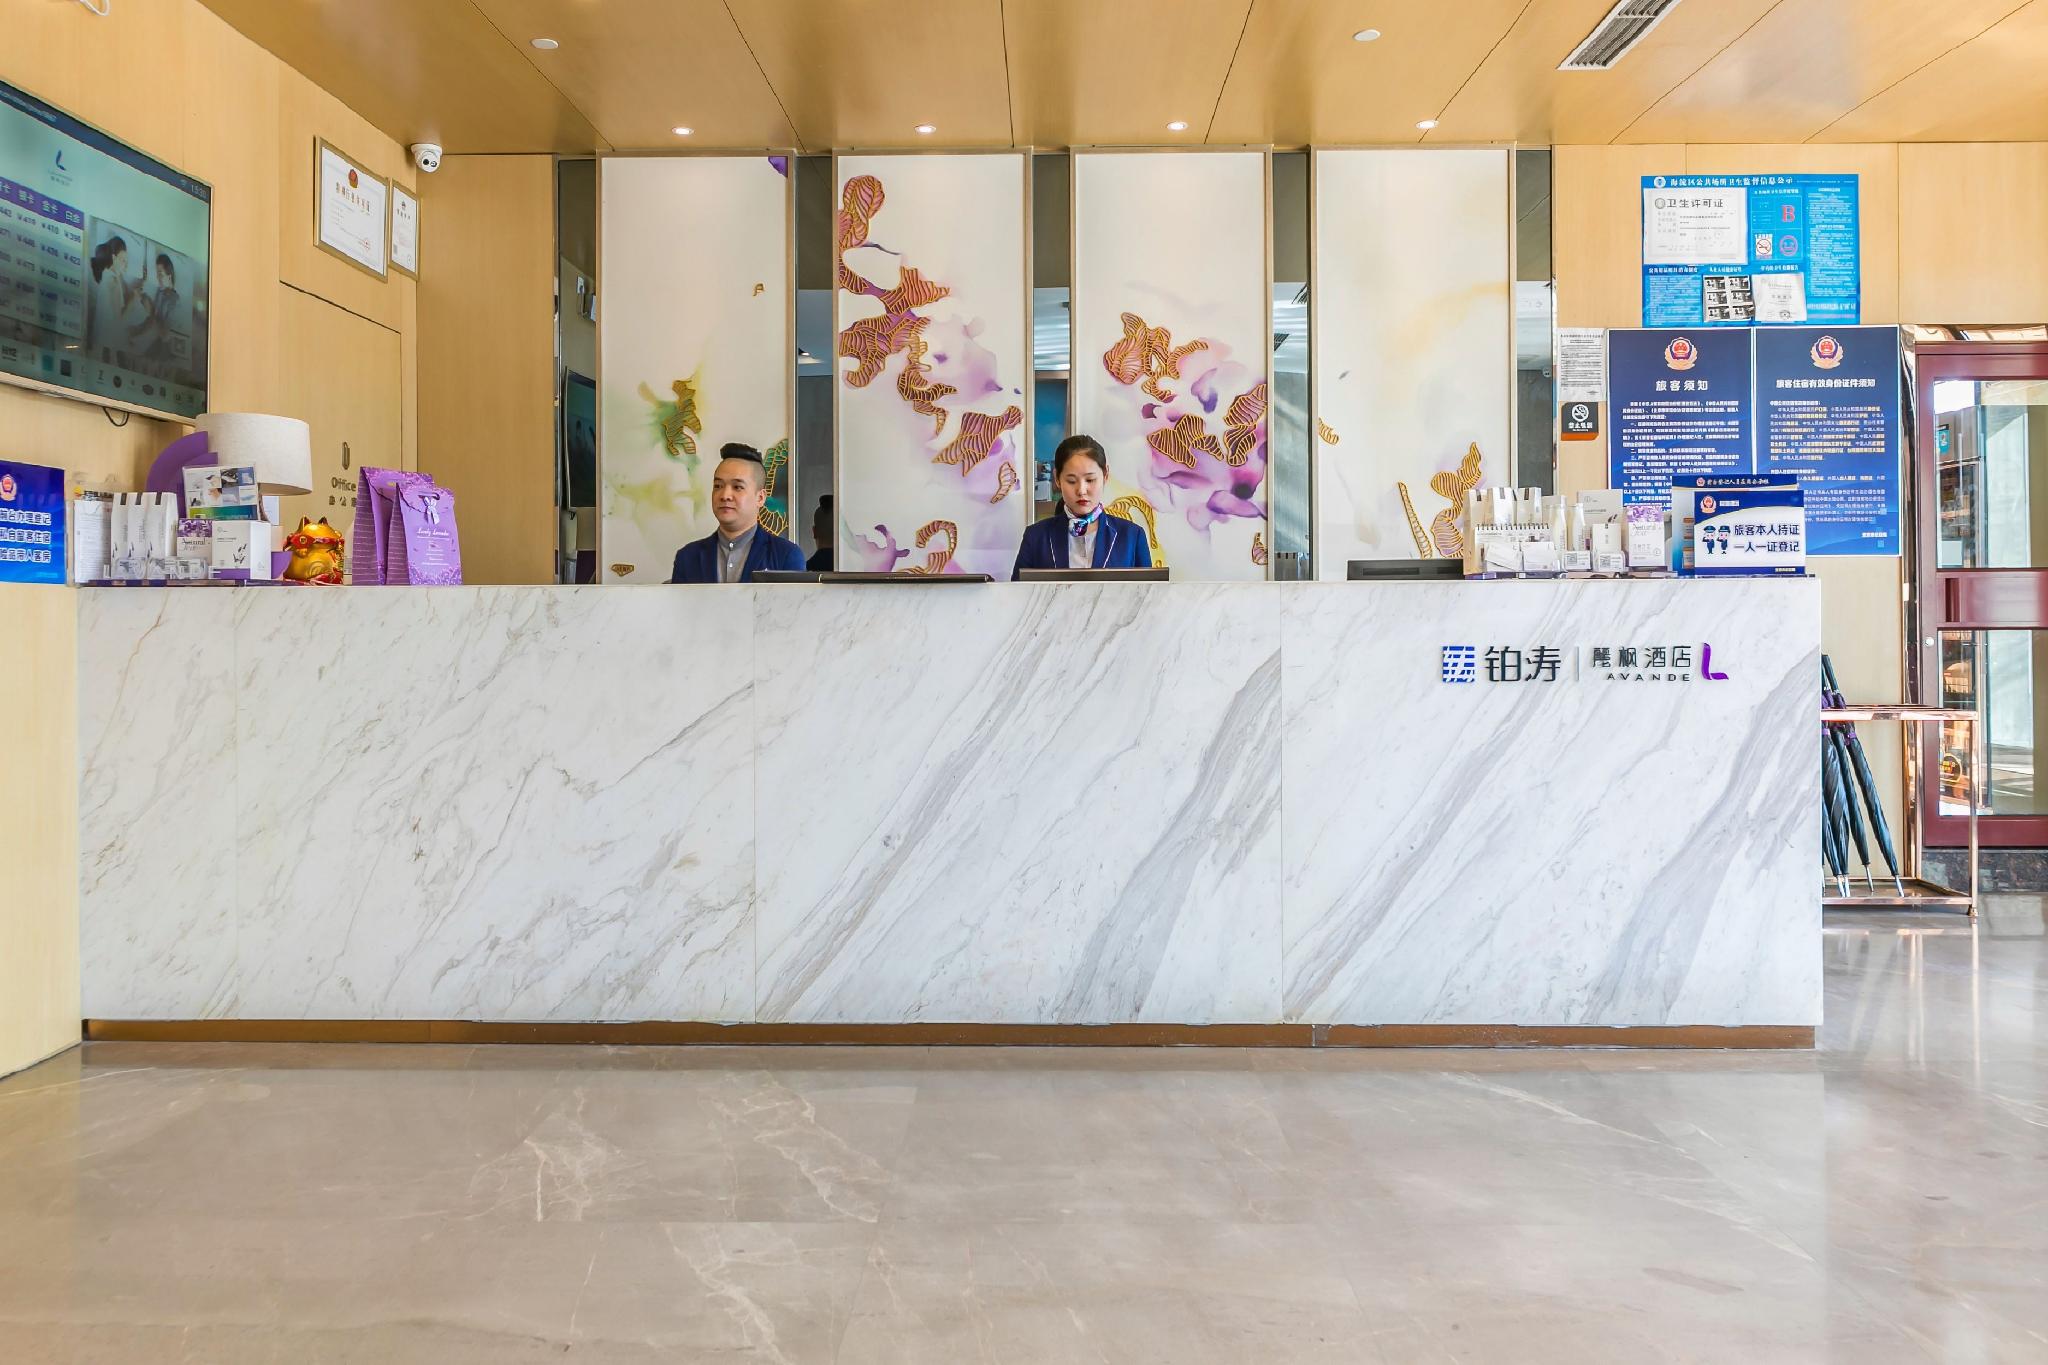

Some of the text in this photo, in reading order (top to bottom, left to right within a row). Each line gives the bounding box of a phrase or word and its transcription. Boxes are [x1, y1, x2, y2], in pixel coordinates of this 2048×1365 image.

[1667, 198, 1723, 208] 卫生许可证
[1782, 205, 1795, 222] B
[1655, 380, 1709, 391] 旅客须知
[1776, 379, 1876, 388] 旅客住宿有效身份证件须知
[1734, 524, 1800, 536] 旅客本人持证
[1734, 541, 1800, 553] 一人一证登记
[1485, 646, 1561, 682] 铂涛
[1607, 673, 1690, 682] AVANDE
